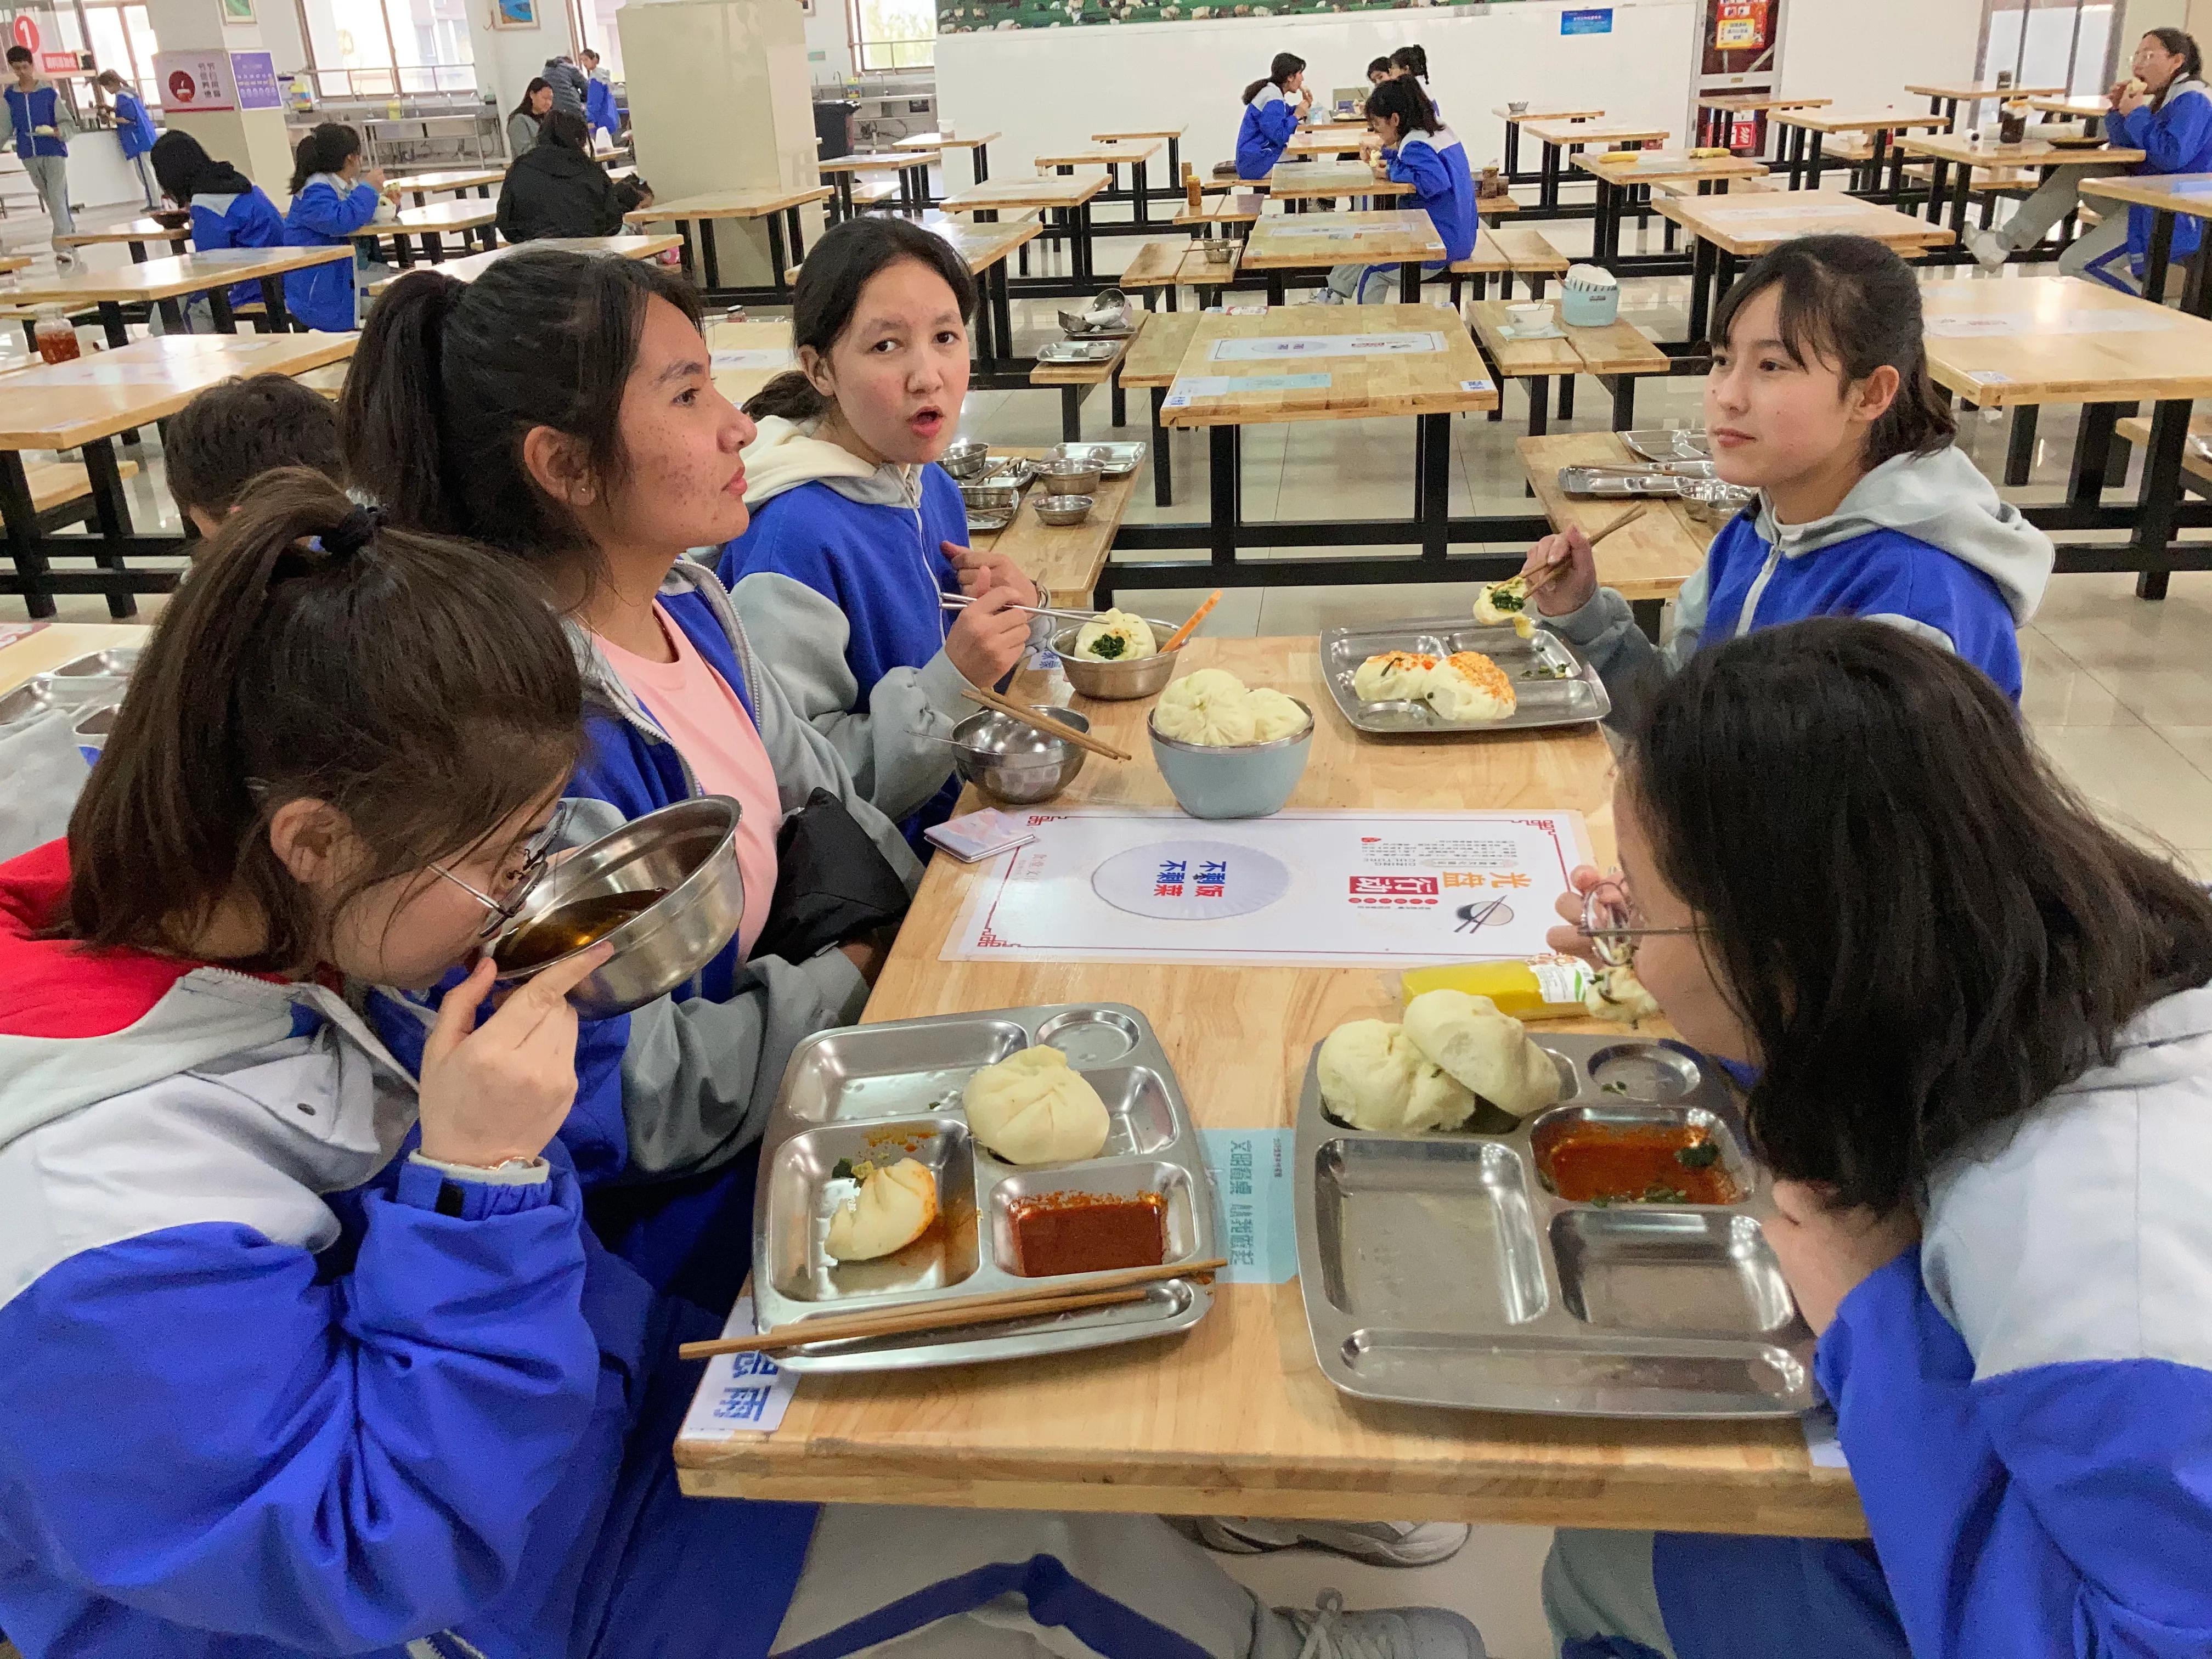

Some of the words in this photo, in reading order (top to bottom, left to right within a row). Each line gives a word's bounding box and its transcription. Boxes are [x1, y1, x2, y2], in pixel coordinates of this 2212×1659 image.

[19, 20, 33, 49] 1
[1153, 860, 1187, 896] 不剩菜
[1194, 860, 1227, 897] 不剩饭
